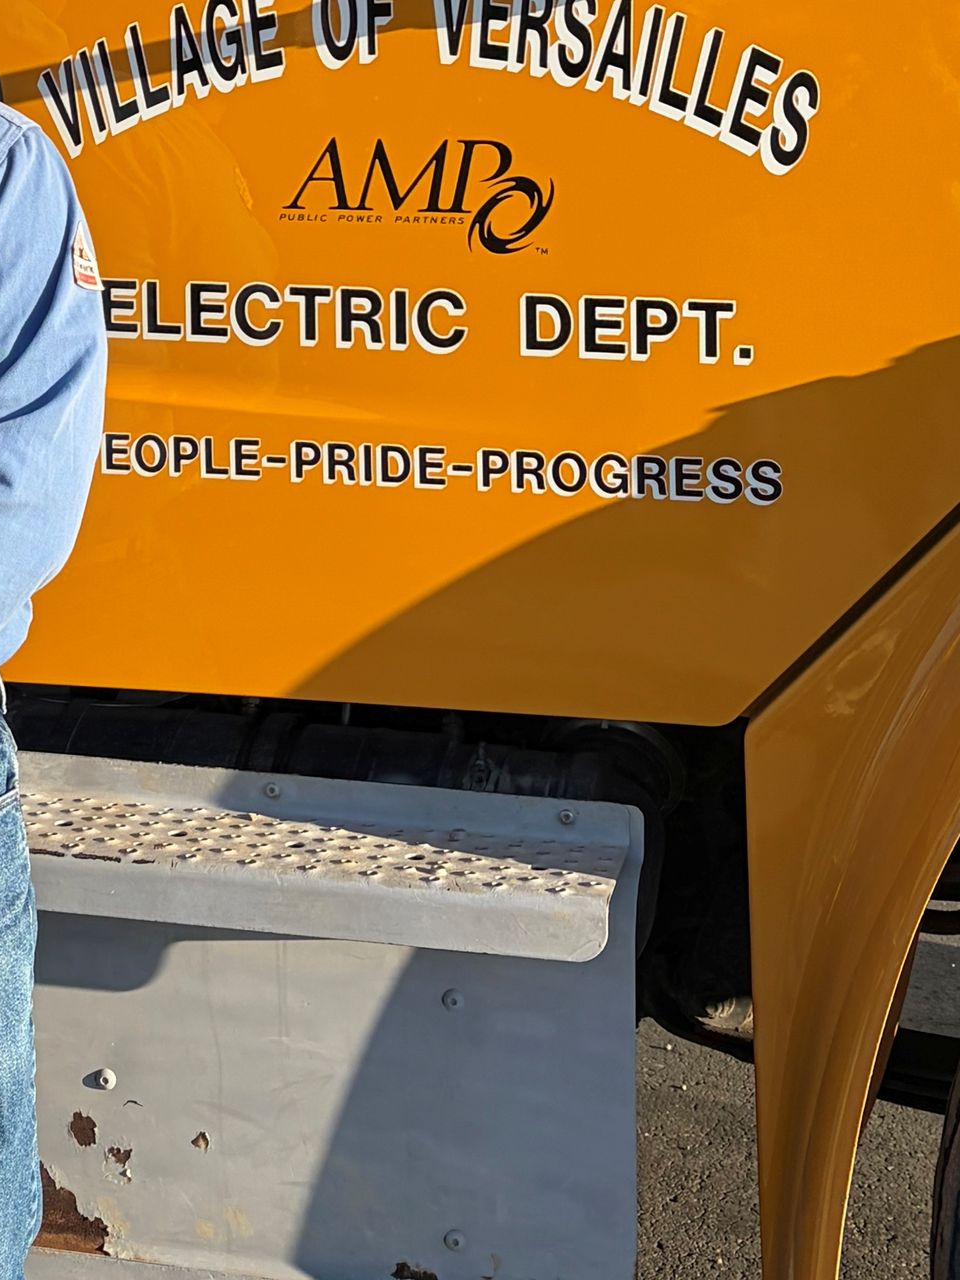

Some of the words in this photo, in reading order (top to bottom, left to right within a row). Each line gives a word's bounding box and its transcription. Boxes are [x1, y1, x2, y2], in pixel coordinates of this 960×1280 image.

[279, 212, 328, 223] PUBLIC
[337, 214, 383, 224] POWER
[394, 215, 466, 226] PARTNERS
[100, 277, 468, 355] ELECTRIC
[519, 292, 754, 366] DEPT.
[100, 432, 783, 506] EOPLE-PRIDE-PROGRESS
